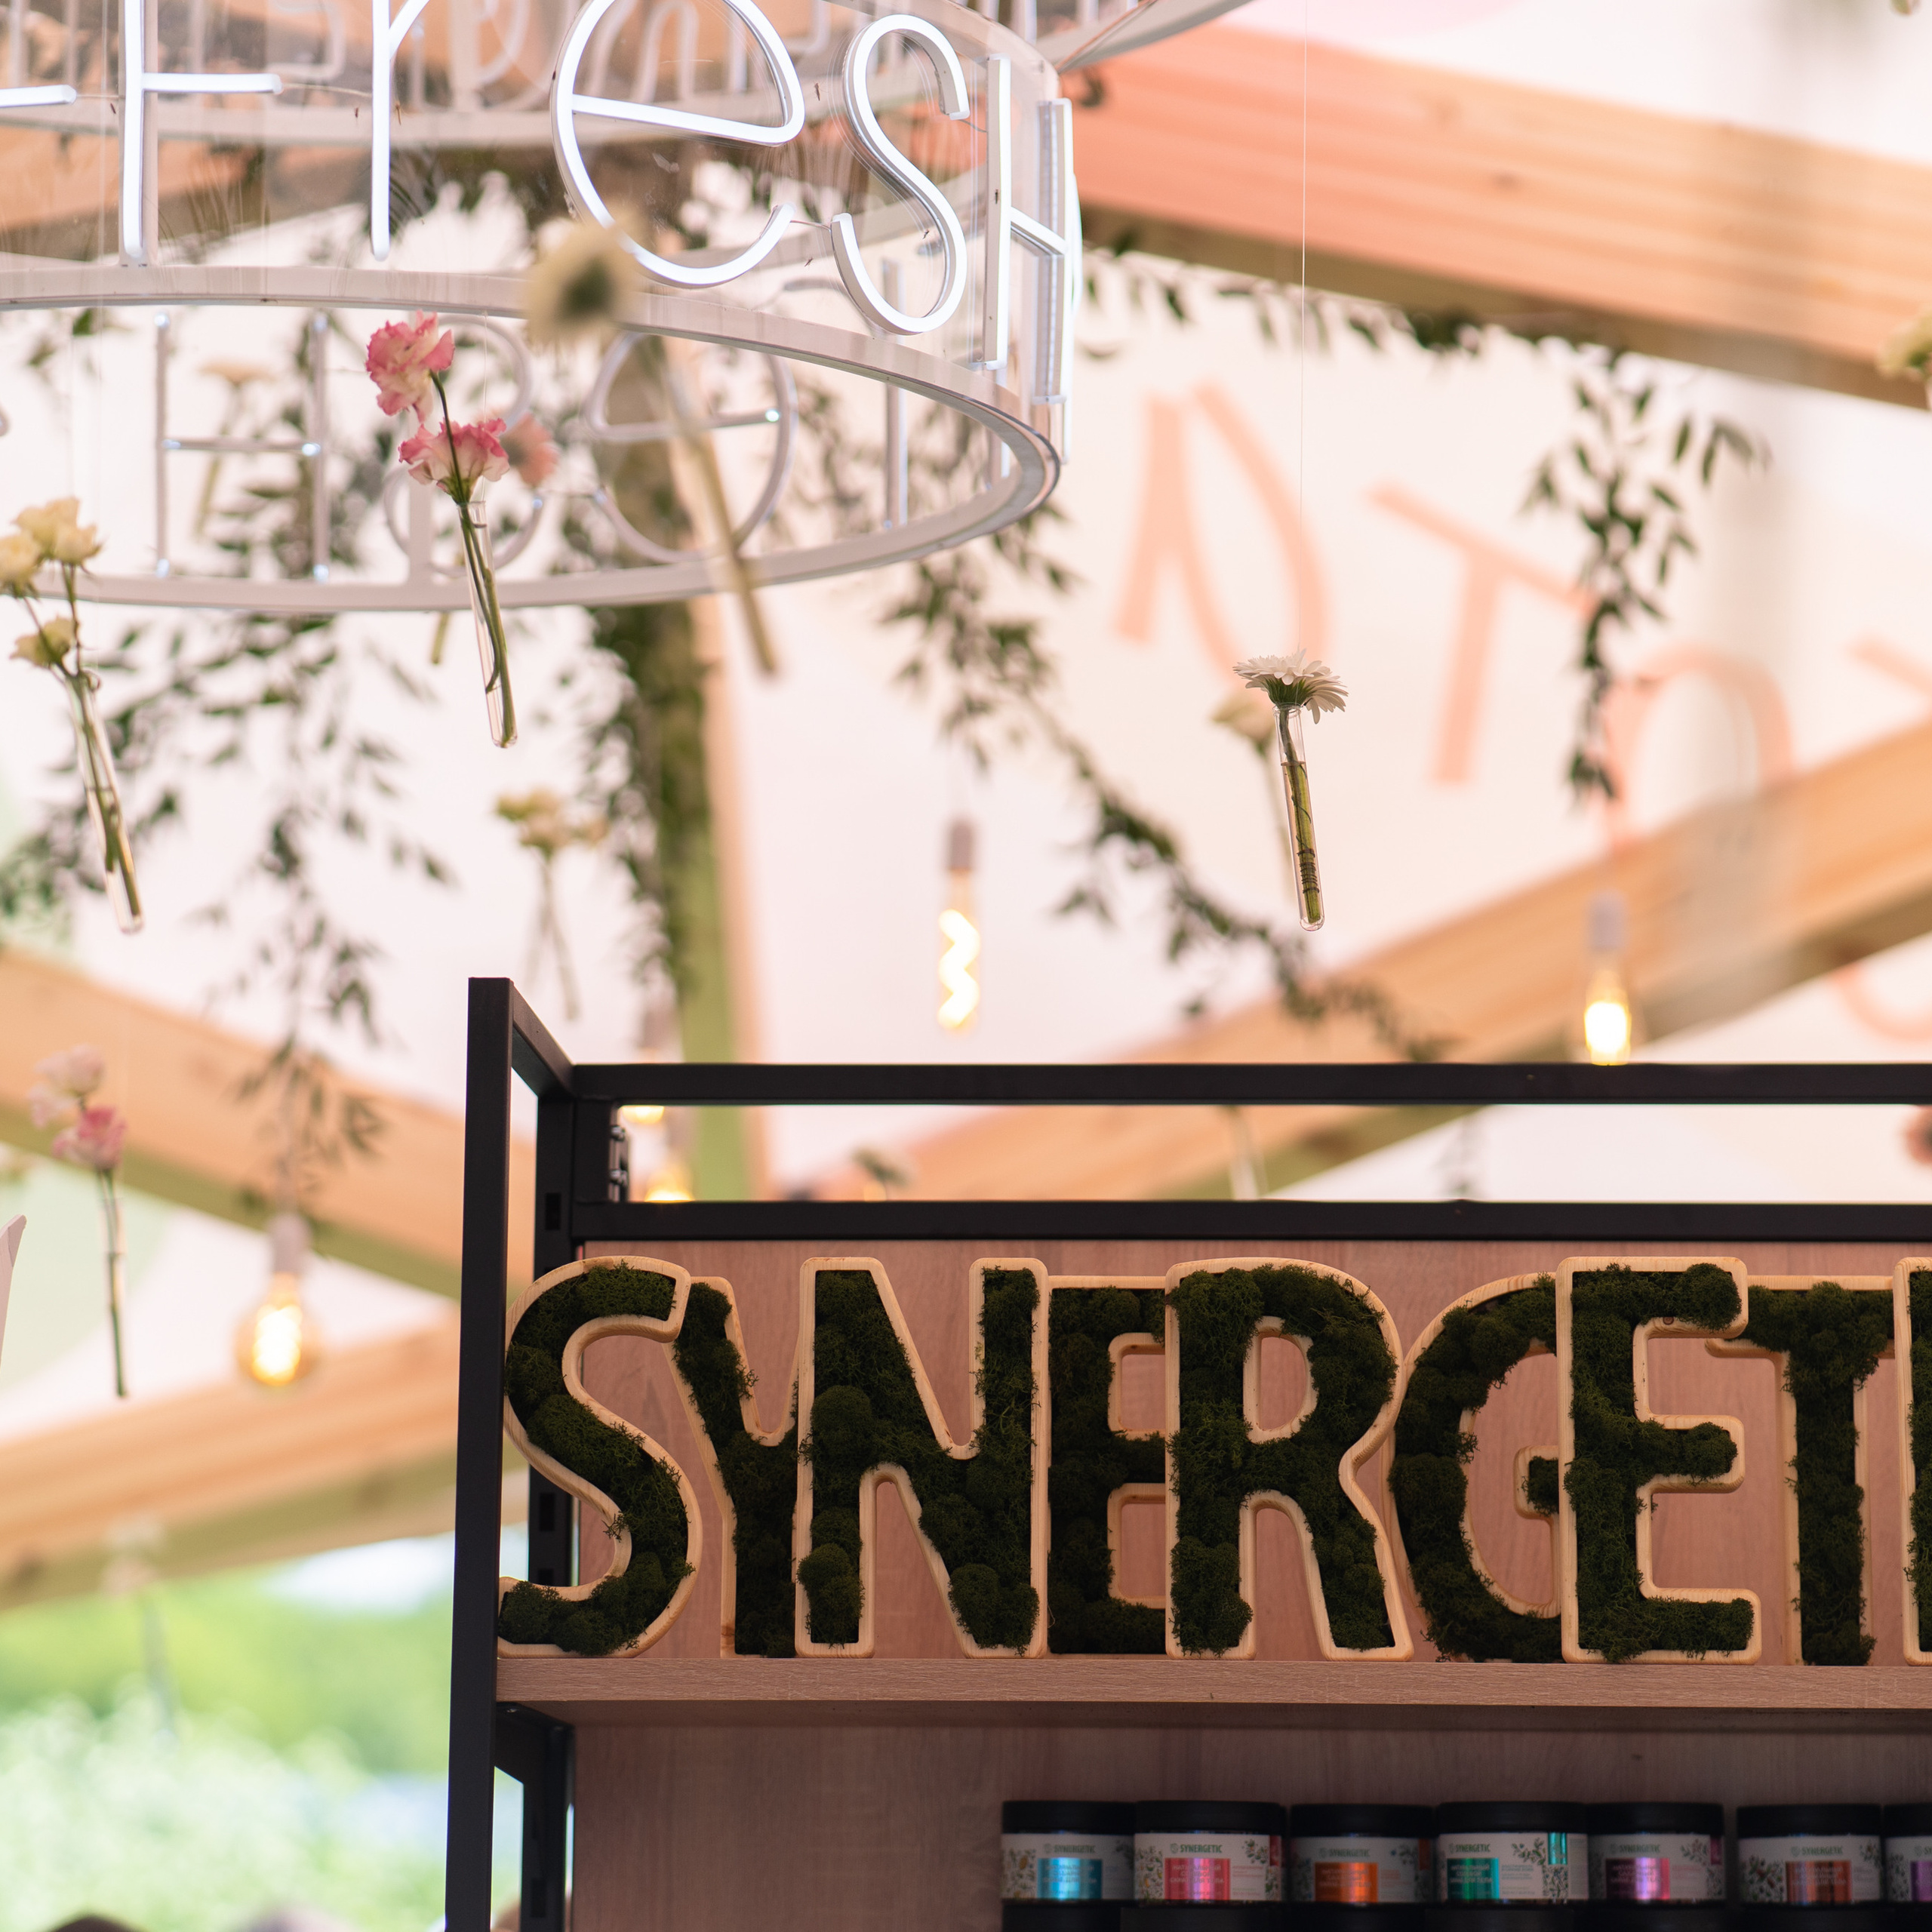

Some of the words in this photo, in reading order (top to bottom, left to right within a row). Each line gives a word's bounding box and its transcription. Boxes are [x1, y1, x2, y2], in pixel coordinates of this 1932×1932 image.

[1180, 1844, 1223, 1854] SYNERGETIC
[1329, 1848, 1371, 1857] SYNERGETIC
[1456, 1844, 1491, 1853] SYNERGETIC
[1801, 1846, 1843, 1856] SYNERGETIC
